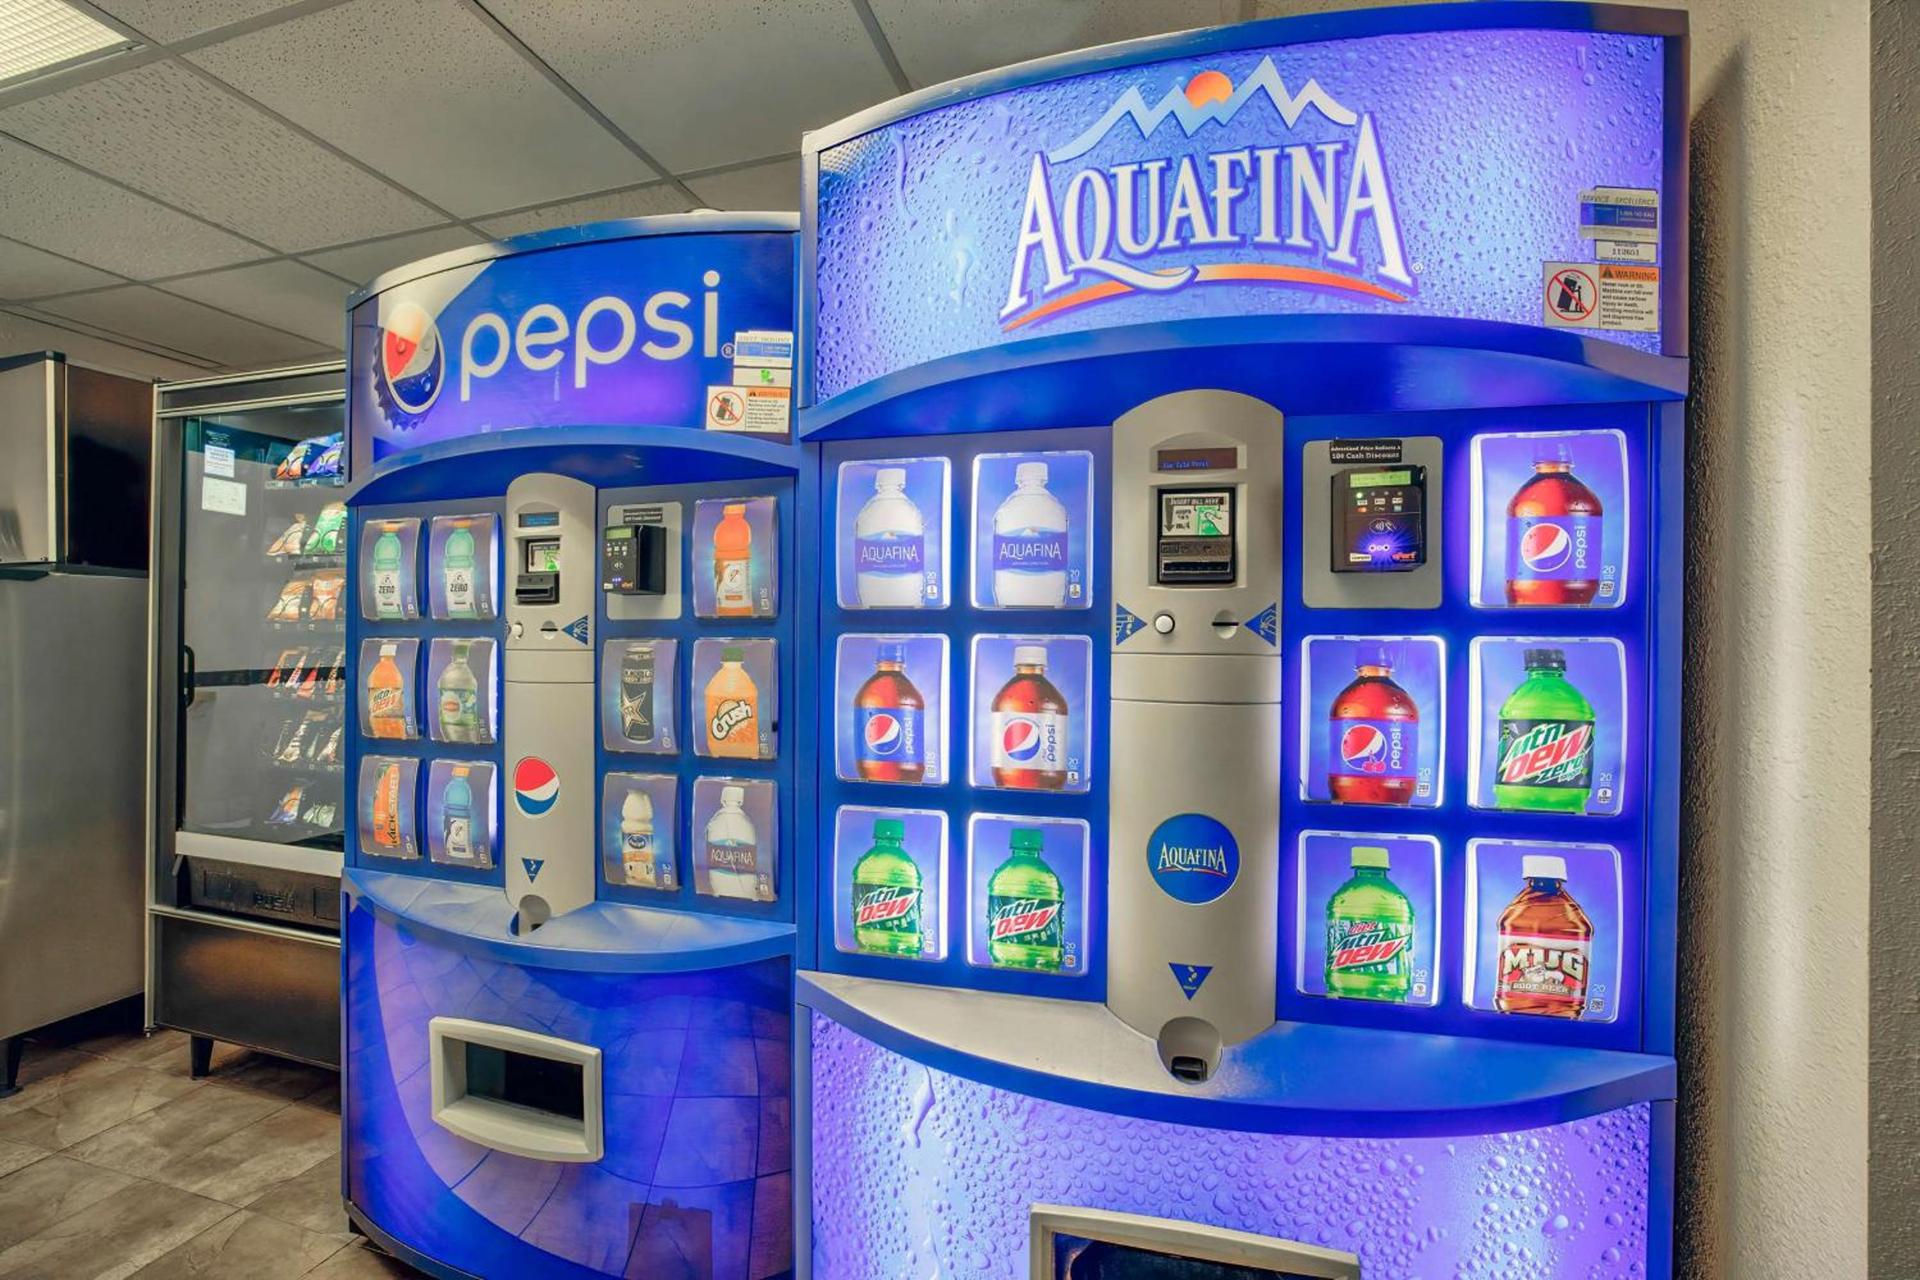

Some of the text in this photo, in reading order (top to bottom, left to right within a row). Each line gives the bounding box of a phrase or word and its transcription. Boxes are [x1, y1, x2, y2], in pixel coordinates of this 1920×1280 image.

[1000, 112, 1413, 318] AQUAFINA
[1616, 270, 1657, 281] WARNING
[460, 270, 720, 401] pepsi
[1366, 452, 1400, 460] Discount
[861, 545, 920, 563] AQUAFINA
[1000, 542, 1061, 560] AQUAFINA
[1574, 525, 1587, 570] pepsi
[712, 700, 752, 740] Crush
[904, 717, 915, 755] pepsi
[1046, 724, 1057, 763] pepsi
[1390, 728, 1402, 769] pepsi
[711, 849, 754, 866] AQUAFINA
[1157, 843, 1227, 874] AQUAFINA
[1503, 948, 1585, 981] MUG
